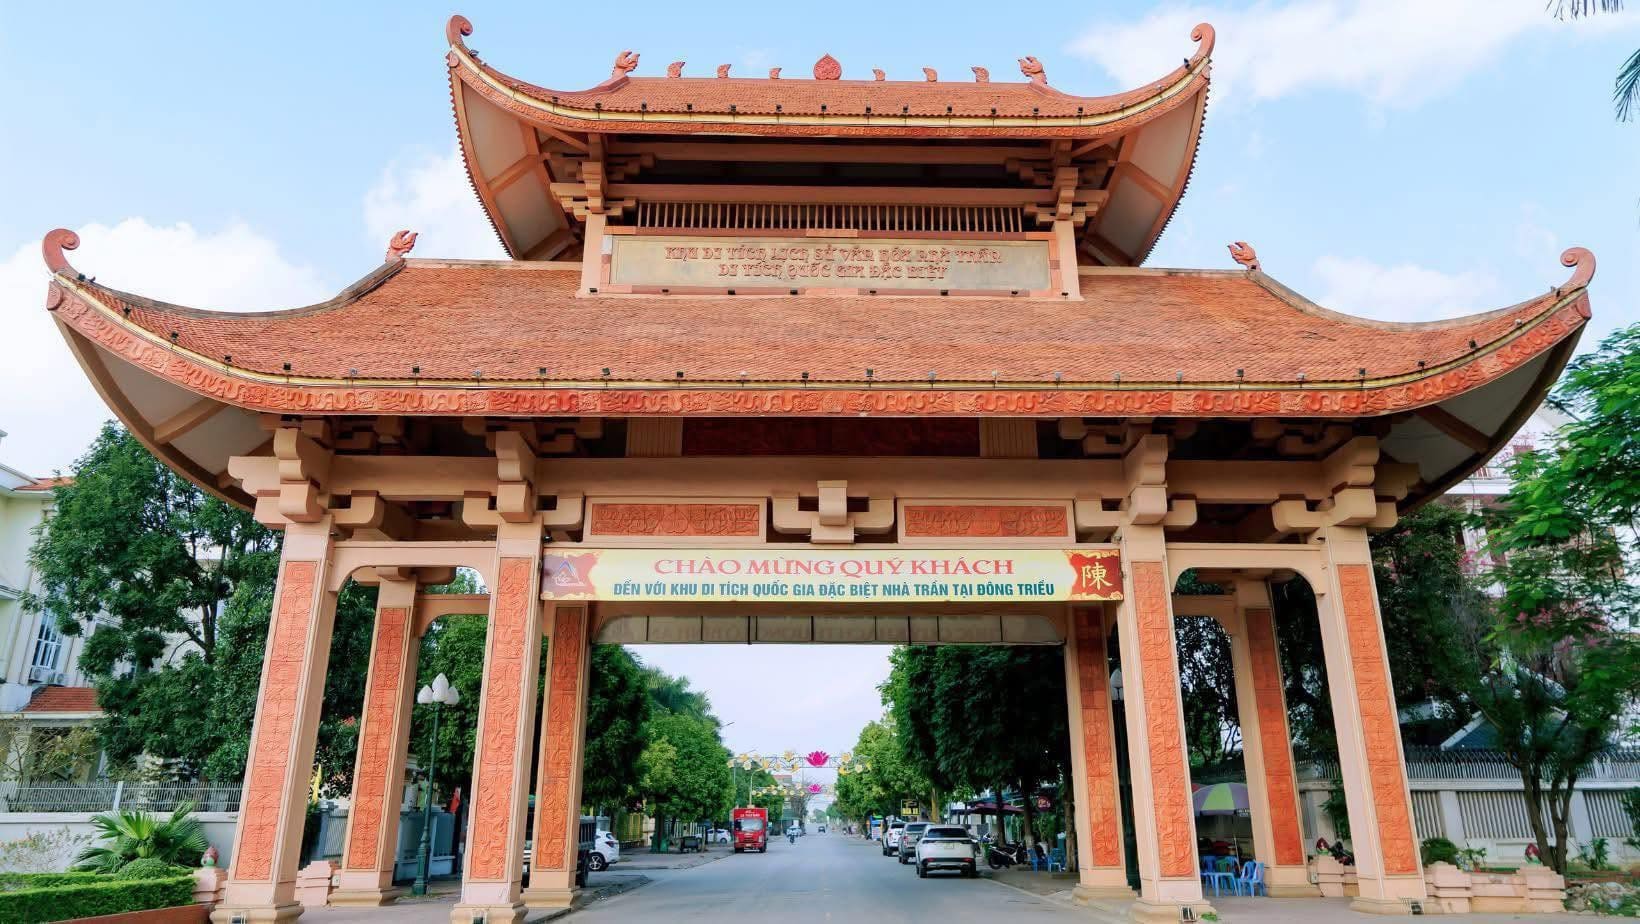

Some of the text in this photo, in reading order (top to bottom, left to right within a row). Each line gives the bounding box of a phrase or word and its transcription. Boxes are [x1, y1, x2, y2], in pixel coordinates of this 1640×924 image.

[653, 556, 741, 575] CHÀO
[839, 556, 904, 579] QUÝ
[911, 556, 1015, 575] KHÁCH
[1082, 565, 1113, 591] 陳
[613, 579, 1055, 599] ĐẾN VỚI KHU DI TÍCH QUỐC GIA ĐẶC BIỆT NHÀ TRẦN TẠI ĐÔNG TRIỀU
